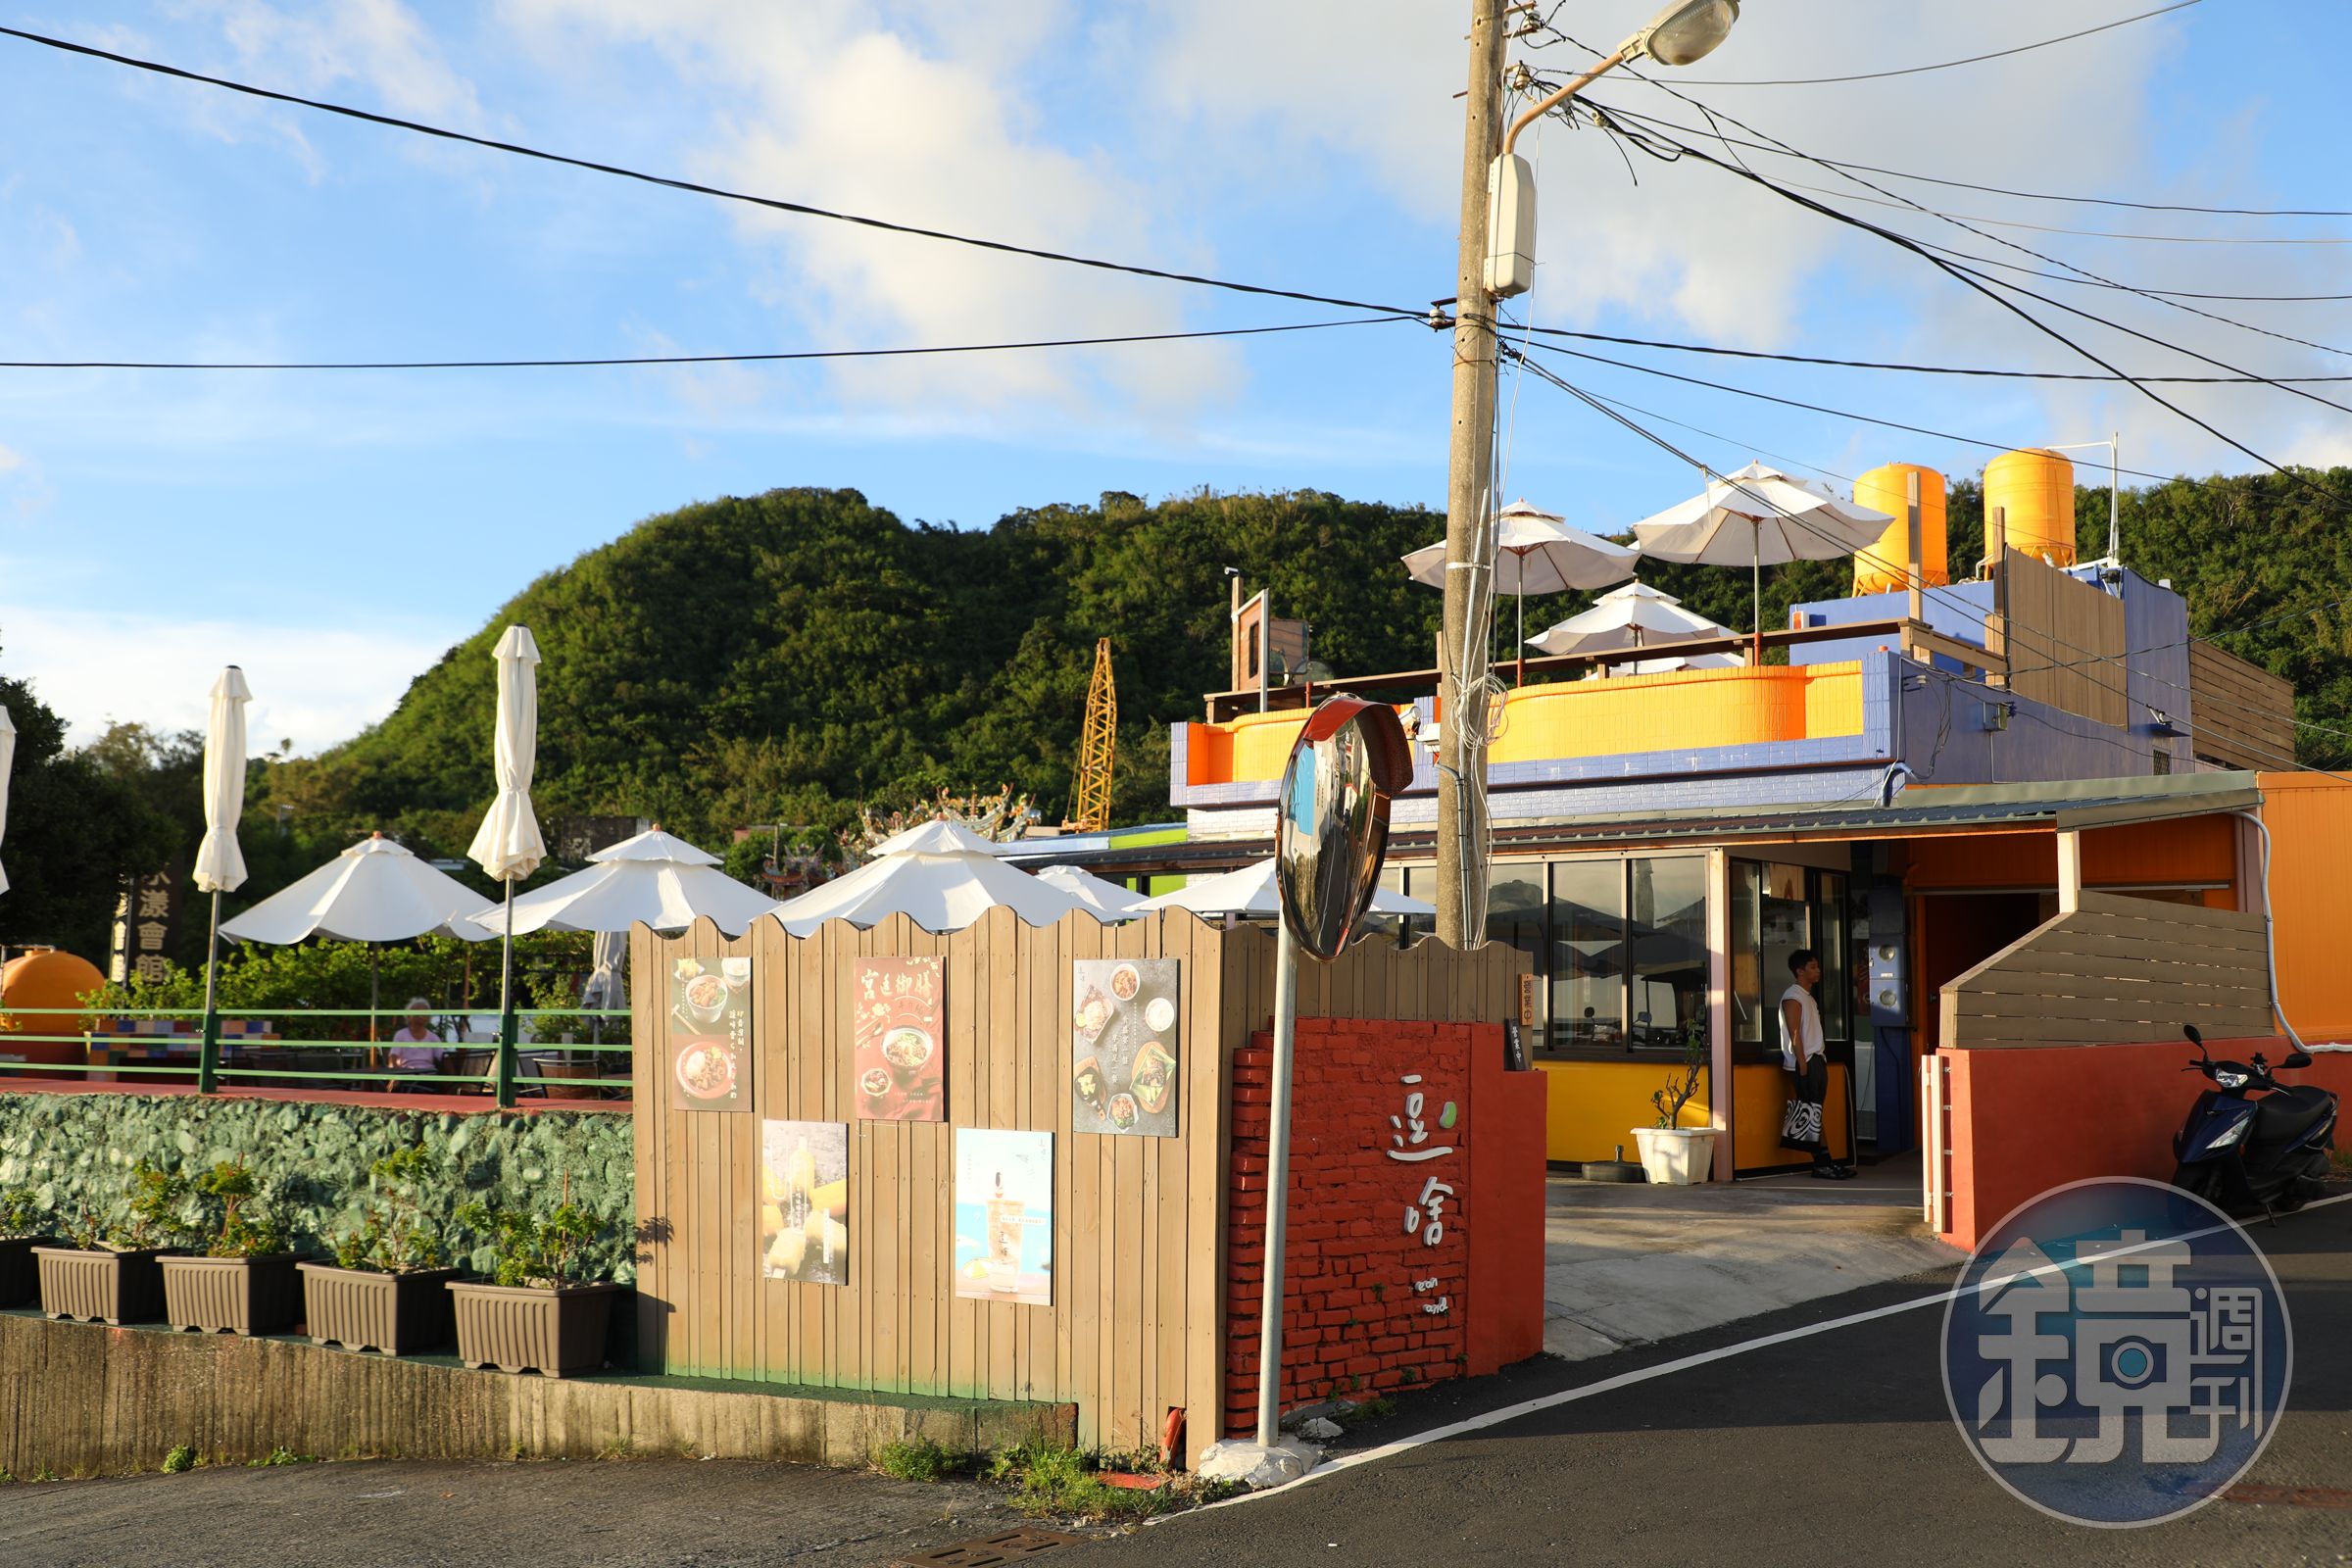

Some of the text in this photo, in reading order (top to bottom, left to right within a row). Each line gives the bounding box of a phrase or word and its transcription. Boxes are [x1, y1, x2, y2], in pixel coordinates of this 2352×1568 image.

[860, 968, 933, 1001] 宮廷御膳
[1511, 1026, 1522, 1063] 營業中
[1386, 1074, 1454, 1247] 逗啥
